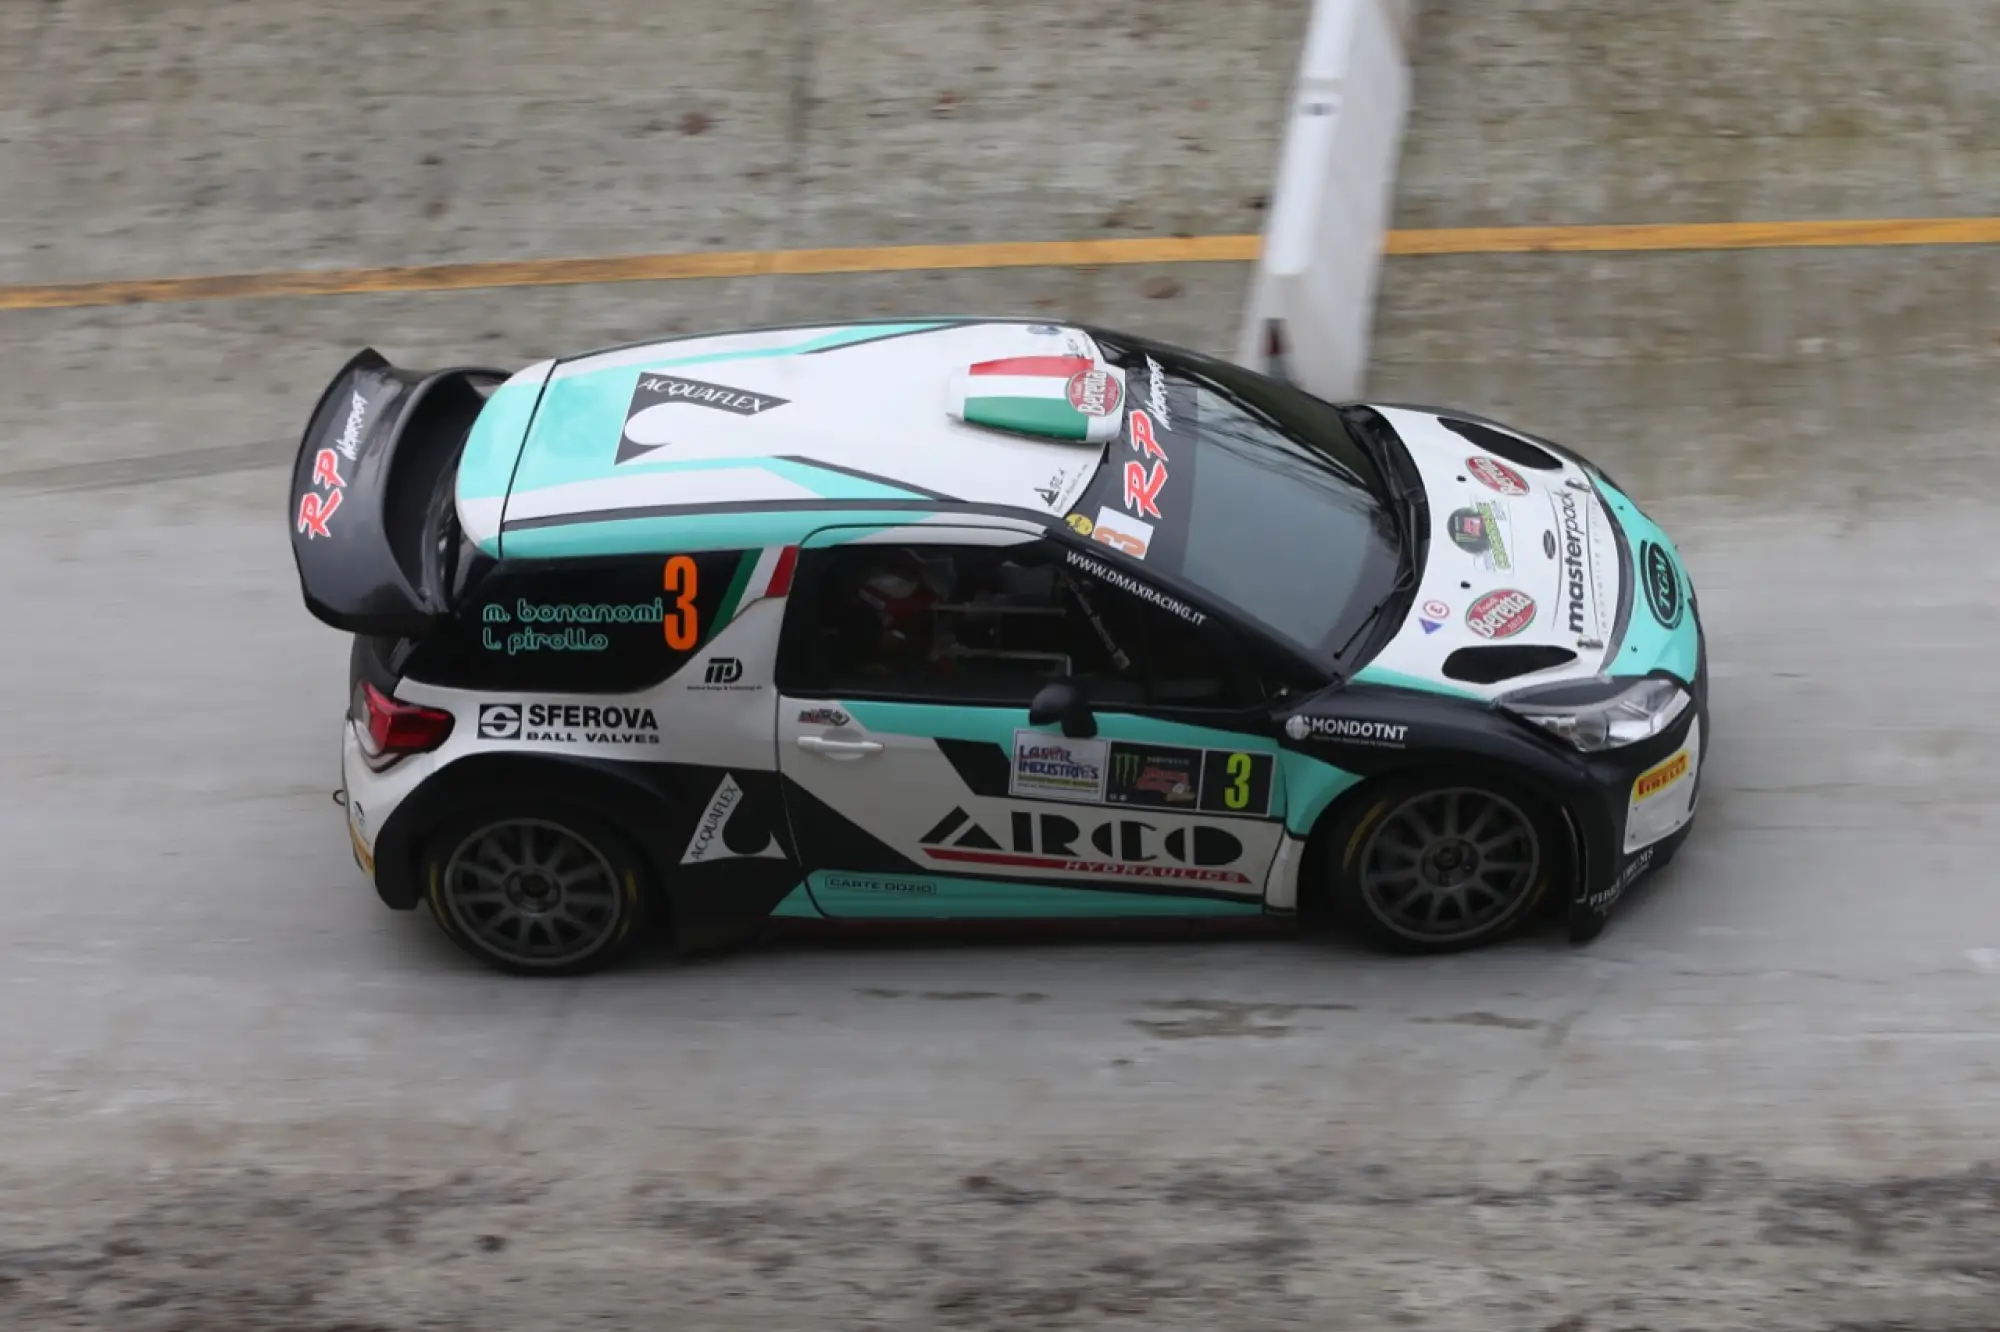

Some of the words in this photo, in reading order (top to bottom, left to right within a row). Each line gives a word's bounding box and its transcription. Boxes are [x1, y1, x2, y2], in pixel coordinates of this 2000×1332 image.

[637, 377, 769, 413] ACQUAFLEX
[1094, 525, 1146, 556] 3
[1553, 485, 1586, 634] masterpack
[664, 556, 697, 650] 3
[1066, 551, 1207, 626] WWW.DMAXRACING.IT
[483, 604, 510, 623] m.
[517, 597, 663, 623] bonanomi
[508, 627, 608, 655] pirollo
[528, 705, 659, 731] SFEROVA
[1312, 717, 1408, 741] MONDOTNT
[526, 732, 577, 743] BALL
[585, 732, 660, 744] VALVES
[1224, 753, 1251, 809] 3
[691, 784, 739, 860] ACQUAFLEX
[917, 806, 1243, 866] ARCO
[830, 877, 880, 890] CARTE
[885, 880, 932, 893] DOZIO
[1064, 861, 1240, 884] HYDRAULICS
